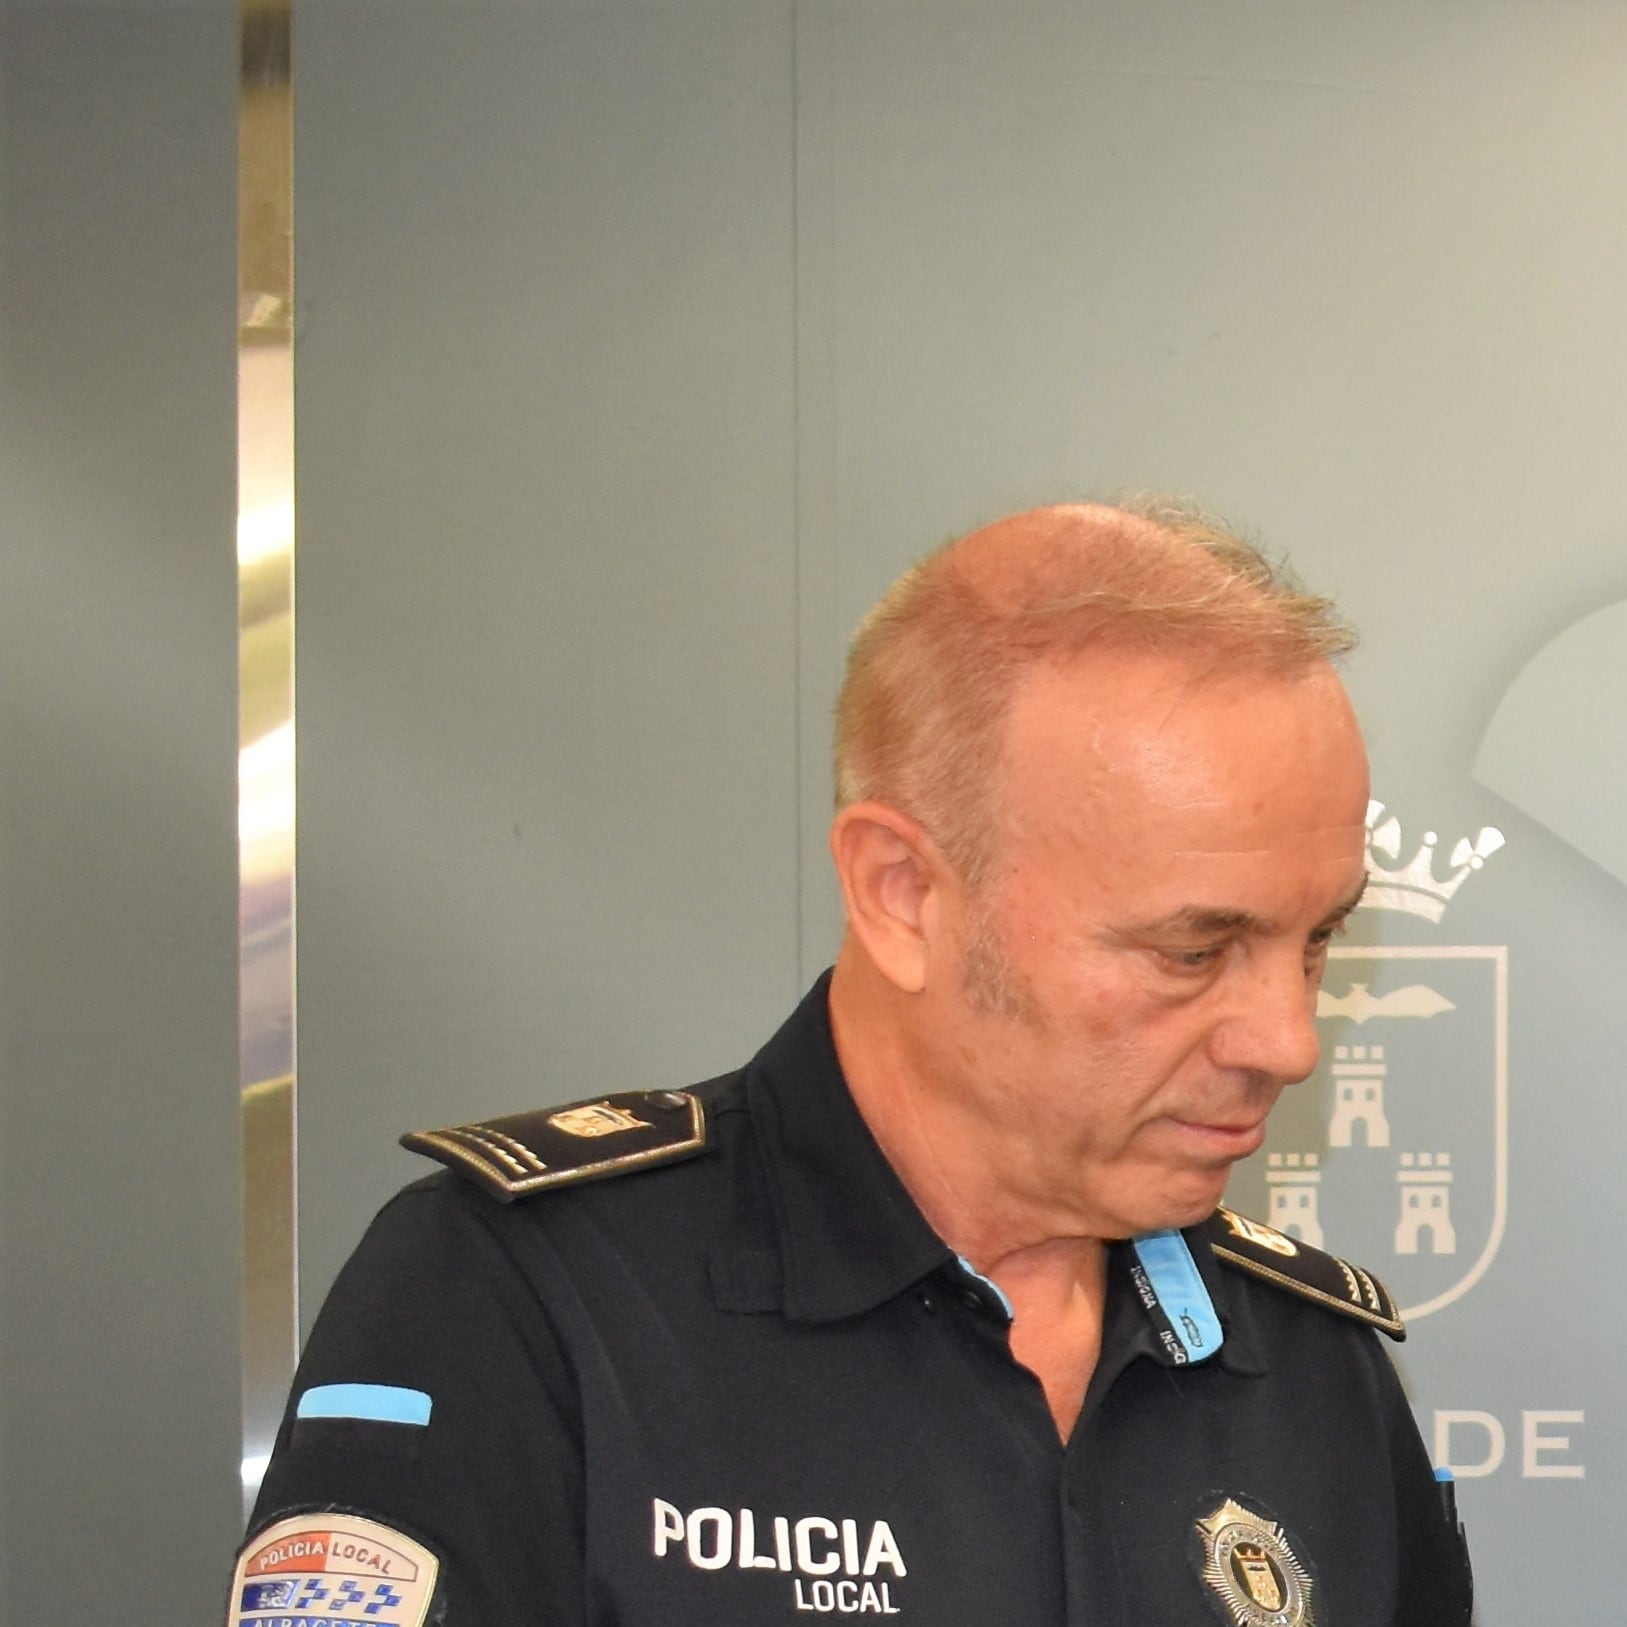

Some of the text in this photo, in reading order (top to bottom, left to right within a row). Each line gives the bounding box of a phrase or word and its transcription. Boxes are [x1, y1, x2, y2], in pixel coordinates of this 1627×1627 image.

[1433, 1410, 1585, 1479] DE
[259, 1540, 394, 1576] POLICIA LOCAL
[651, 1497, 907, 1577] POLICIA
[795, 1578, 901, 1614] LOCAL
